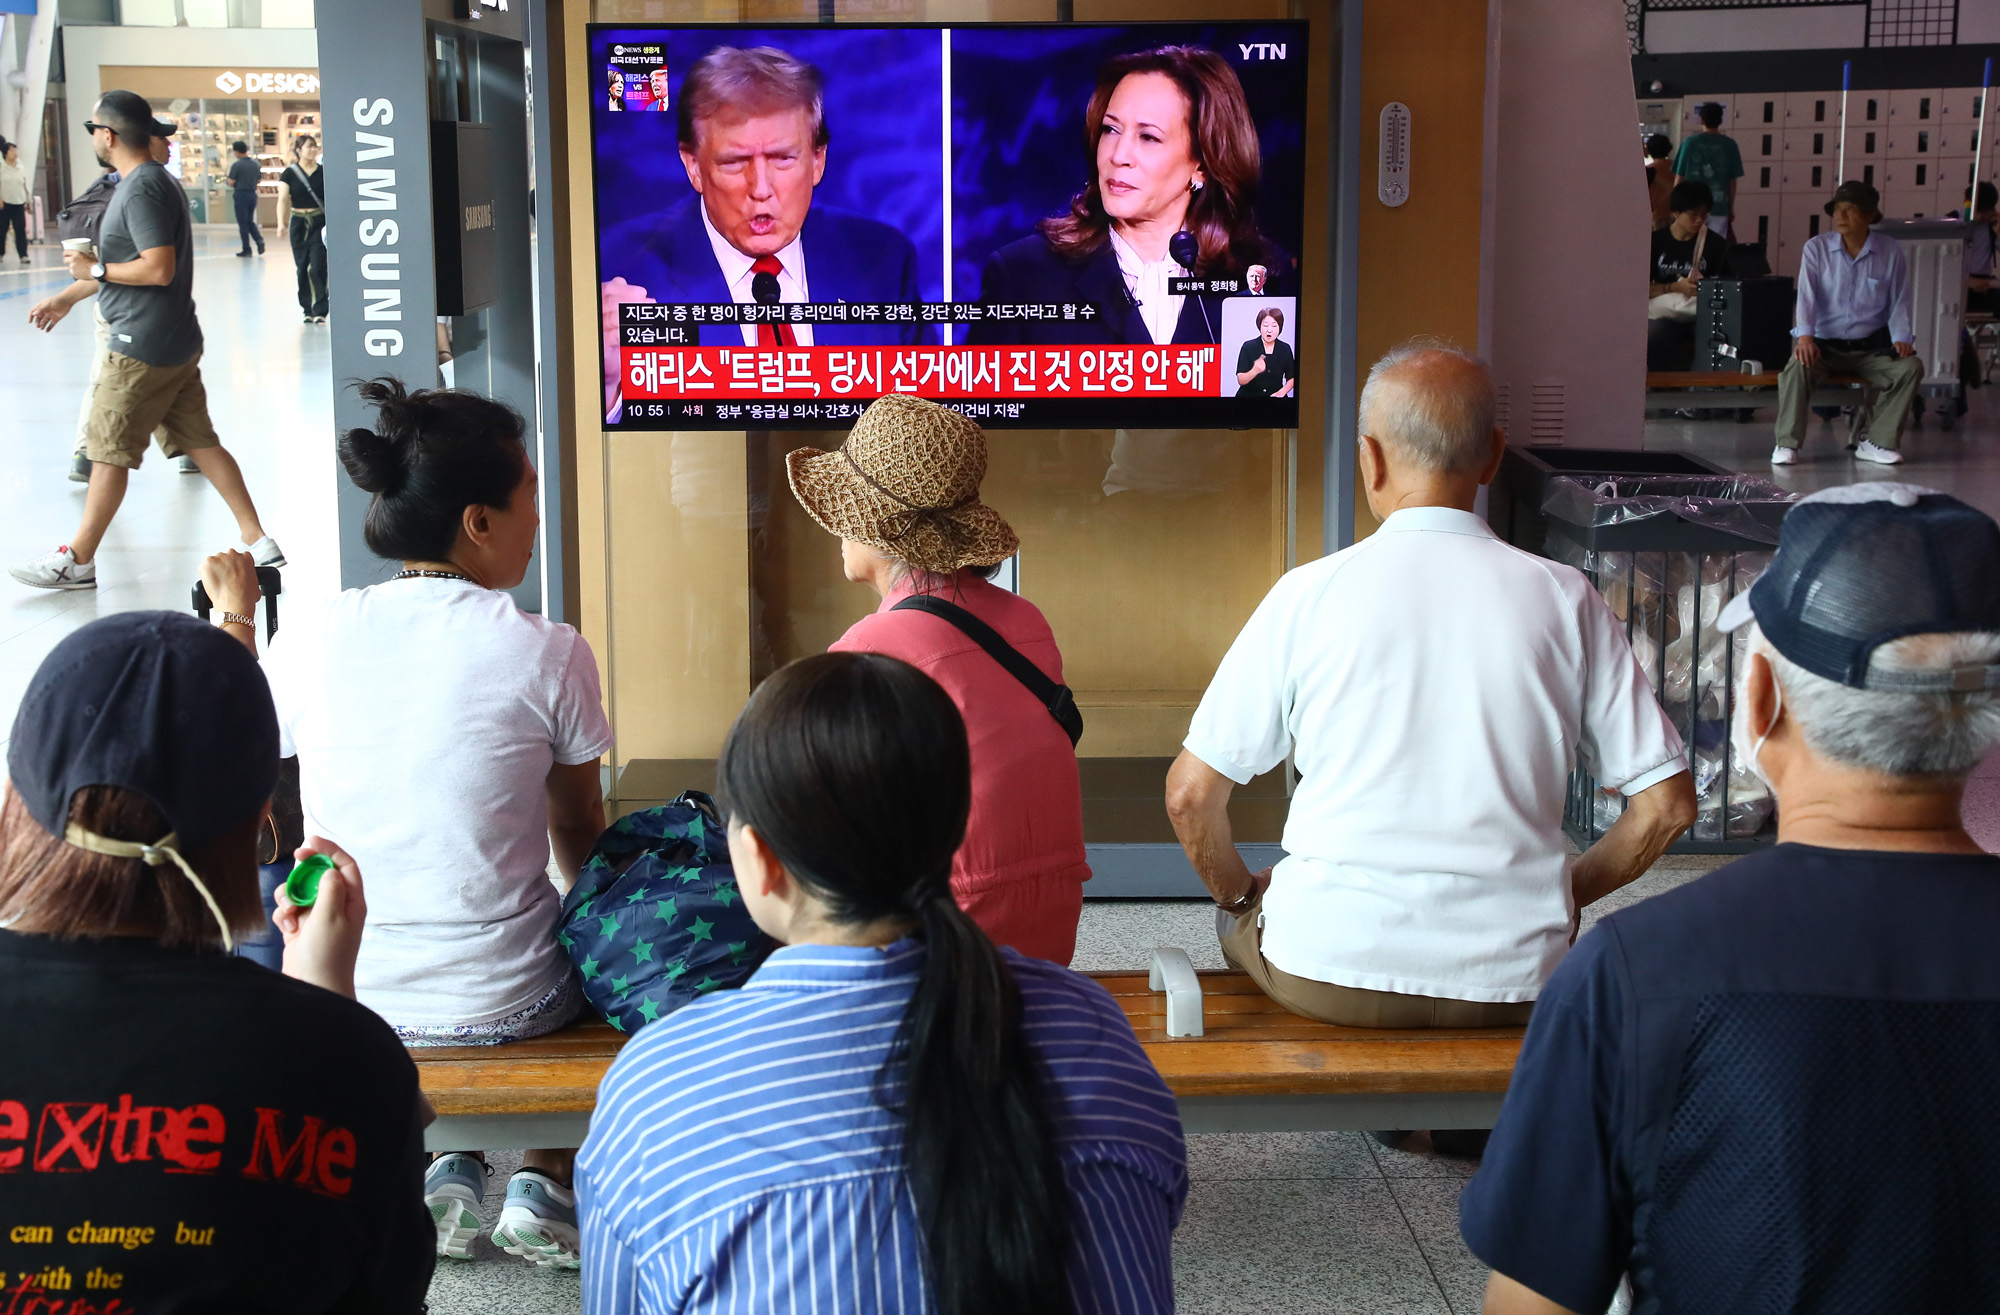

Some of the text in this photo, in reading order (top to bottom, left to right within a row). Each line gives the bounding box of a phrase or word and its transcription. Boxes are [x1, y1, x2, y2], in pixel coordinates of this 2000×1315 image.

[624, 46, 642, 54] NEWS
[643, 46, 660, 54] 생중계
[1238, 43, 1287, 60] YTN
[610, 56, 624, 64] 미국
[625, 56, 639, 64] 대선
[245, 73, 320, 93] DESIGN
[625, 73, 649, 82] 해리스
[626, 91, 650, 100] 트럼프
[353, 98, 404, 356] SAMSUNG
[1176, 280, 1238, 292] 동시 통역 정희형
[626, 304, 1096, 322] 지도자 중 한 명이 헝가리 총리인데 아주 강한, 강단 있는 지도자라고 할 수
[626, 327, 689, 344] 있습니다.
[629, 347, 1215, 397] 해리스 "트럼프, 당시 선거에서 진 것 인정 안 해"
[628, 405, 664, 417] 10 55
[682, 405, 703, 417] 사회
[716, 405, 742, 419] 정부
[746, 404, 789, 419] "응급실
[994, 402, 1025, 418] 지원"
[10, 1220, 214, 1250] can change but
[86, 1266, 123, 1289] the
